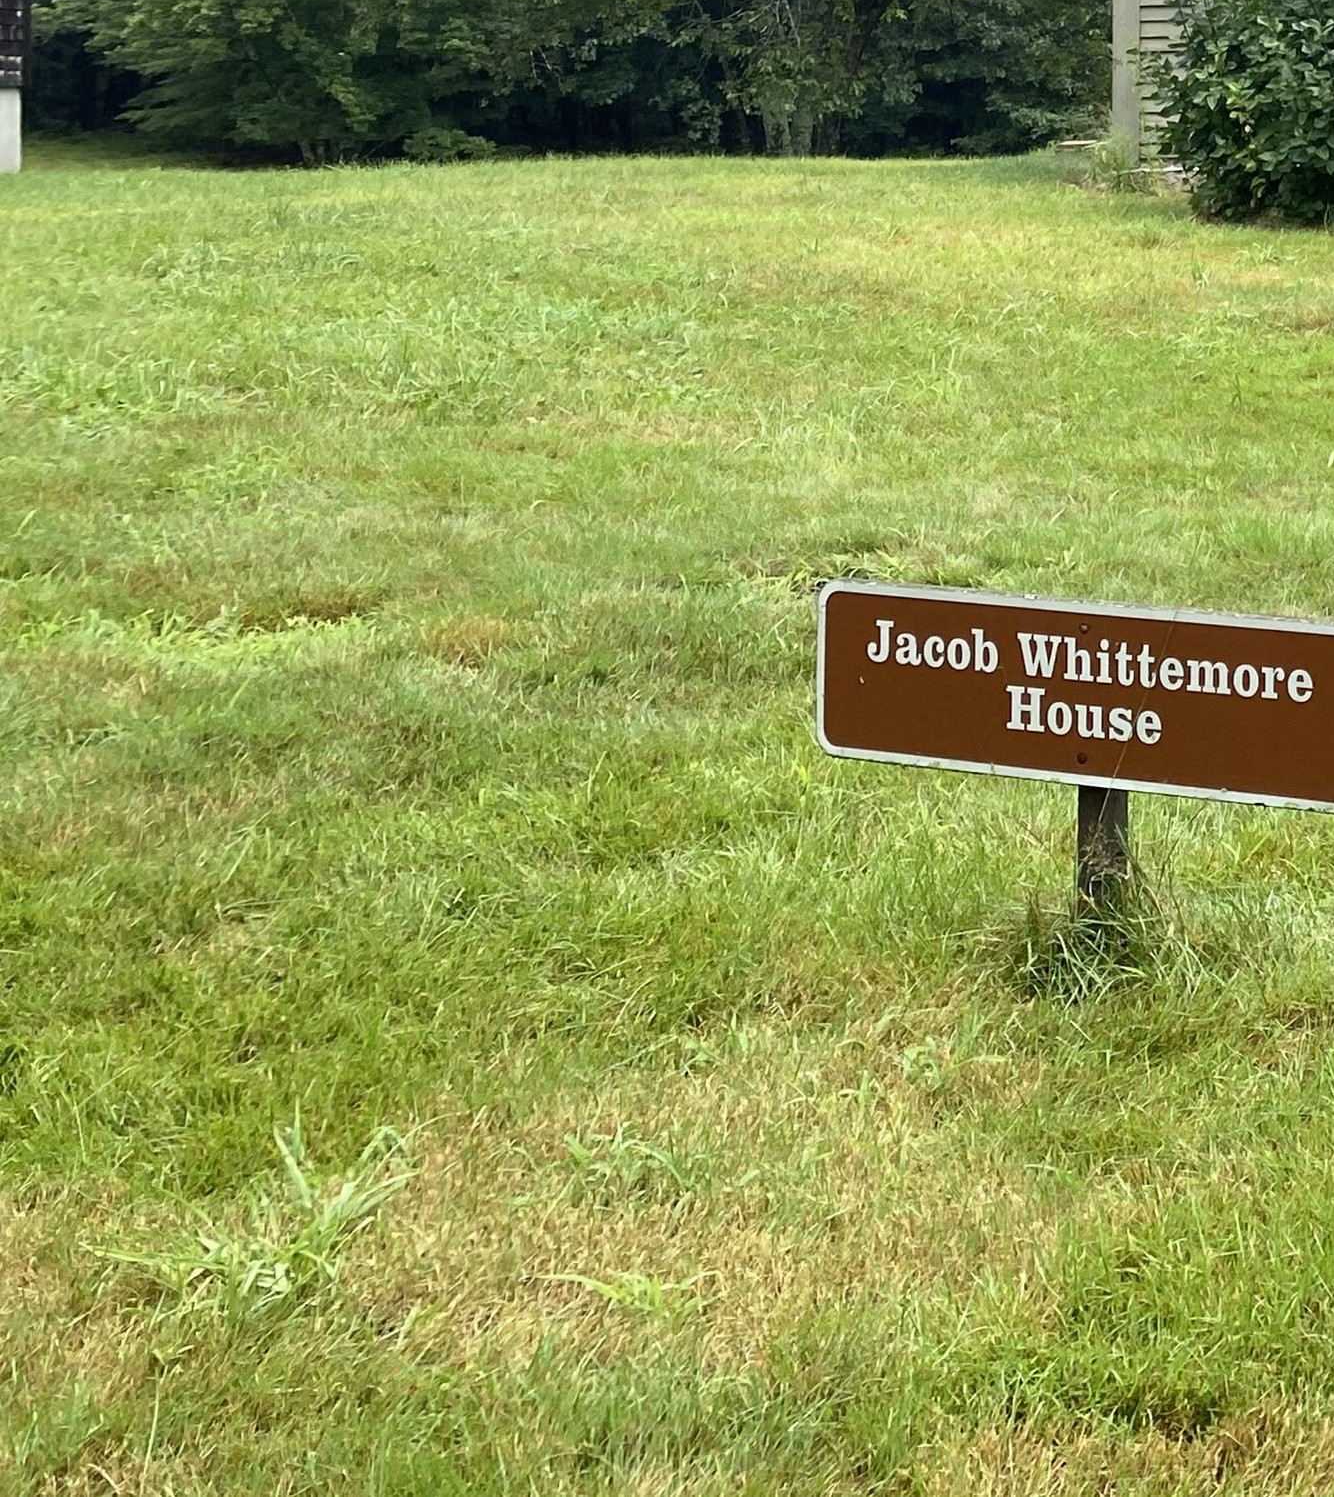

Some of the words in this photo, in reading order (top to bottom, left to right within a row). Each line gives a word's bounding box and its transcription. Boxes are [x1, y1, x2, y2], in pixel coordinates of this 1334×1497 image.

[867, 619, 999, 673] Jacob
[1017, 632, 1314, 703] Whittemore
[1006, 685, 1163, 745] House
